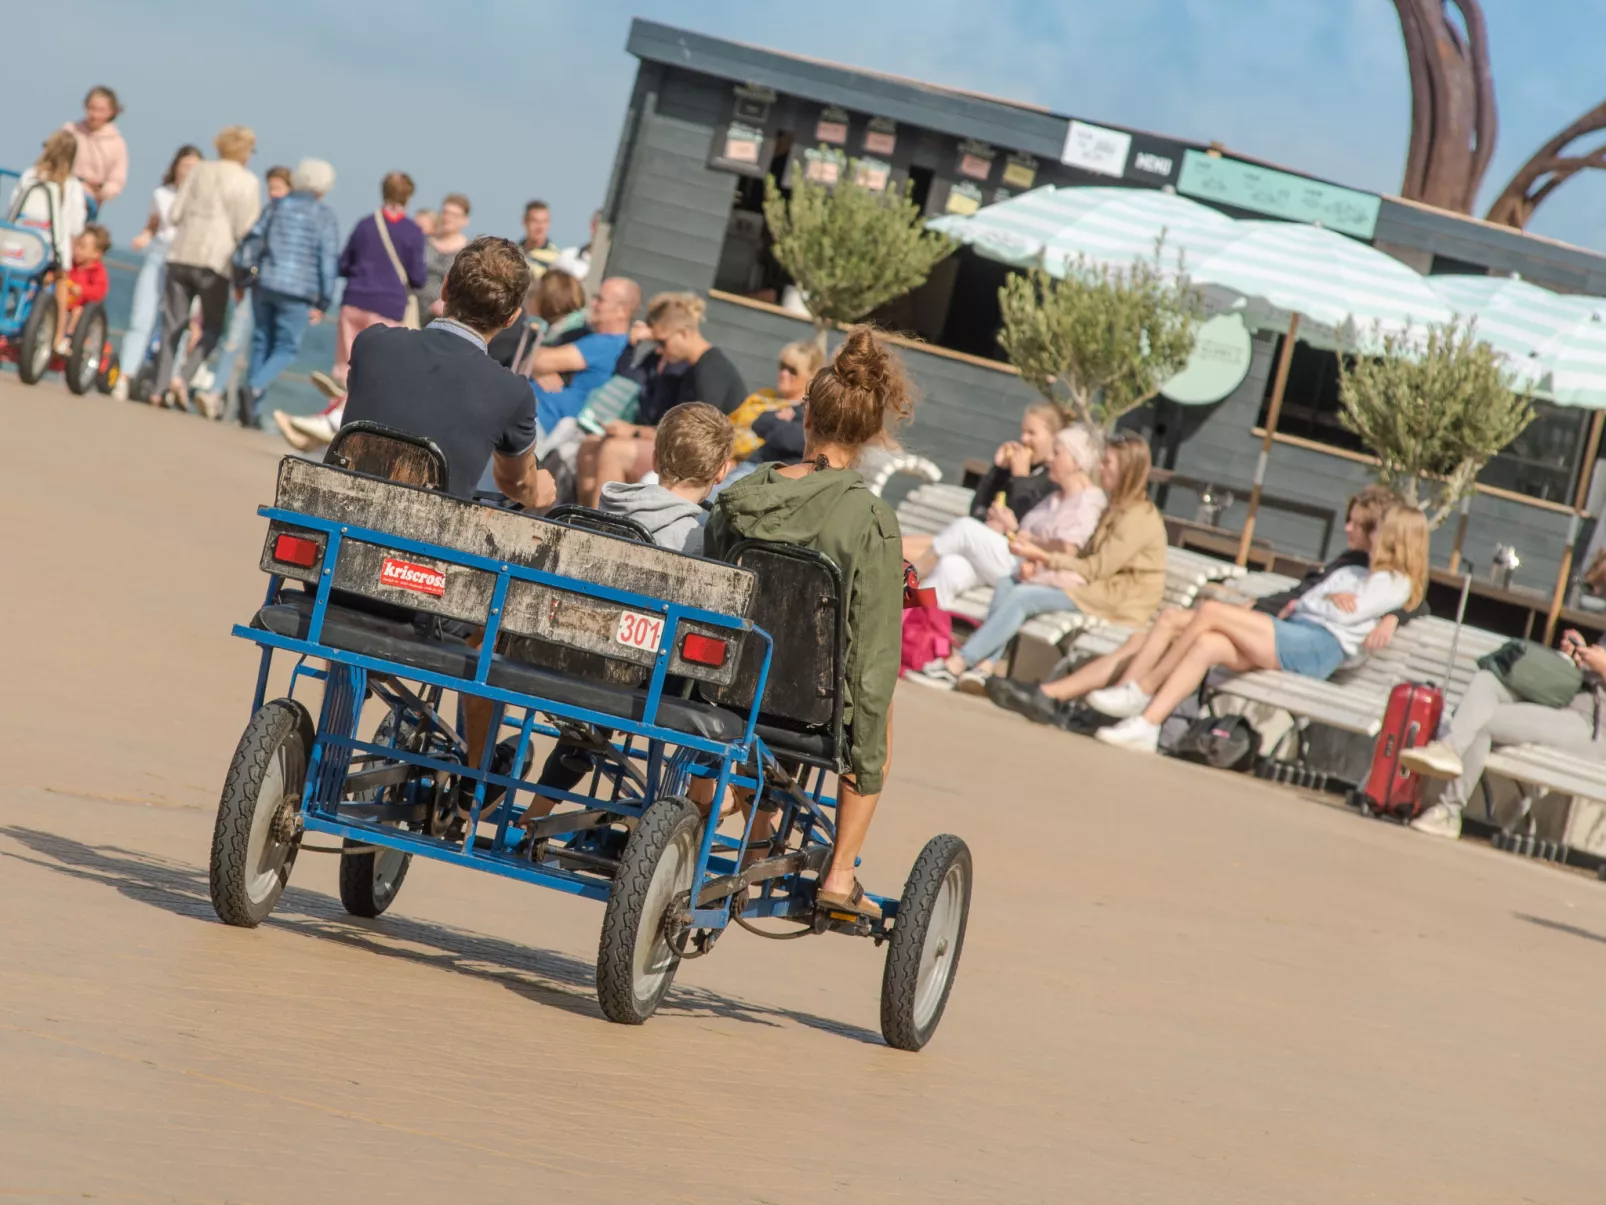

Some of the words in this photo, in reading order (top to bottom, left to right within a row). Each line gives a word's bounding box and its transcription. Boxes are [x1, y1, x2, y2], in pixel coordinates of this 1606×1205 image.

[1136, 152, 1172, 176] MENU
[384, 561, 445, 588] kriscross
[621, 614, 660, 649] 301
